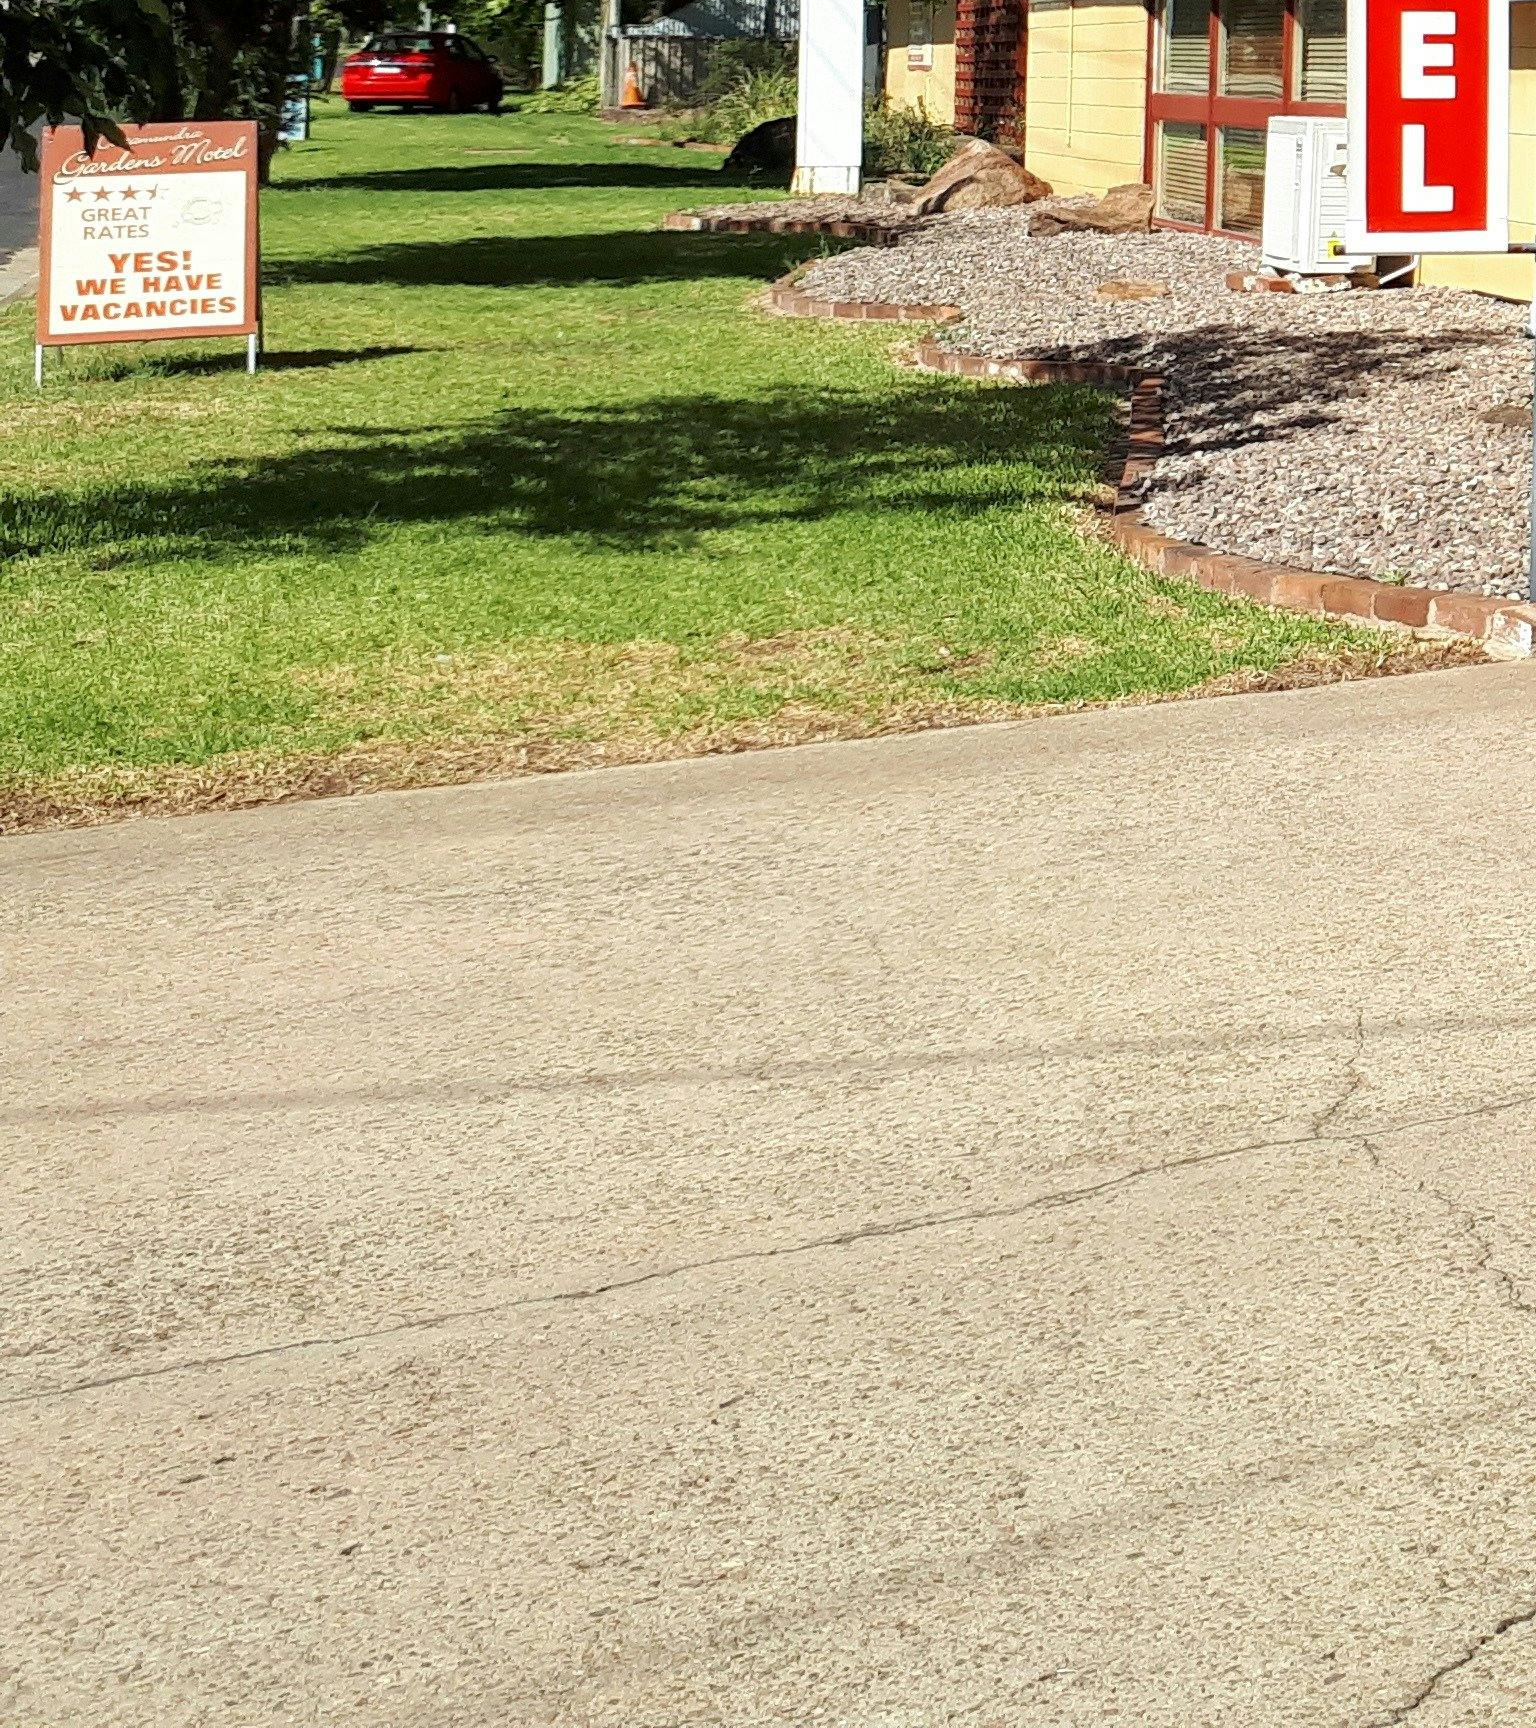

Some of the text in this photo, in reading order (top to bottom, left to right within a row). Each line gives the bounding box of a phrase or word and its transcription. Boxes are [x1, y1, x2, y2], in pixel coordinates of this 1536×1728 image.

[53, 135, 249, 186] Gardens Motel
[81, 206, 153, 222] GREAT
[83, 224, 150, 240] RATES
[108, 250, 193, 274] YES!
[76, 273, 223, 296] WE HAVE
[60, 296, 237, 322] VACANCIES
